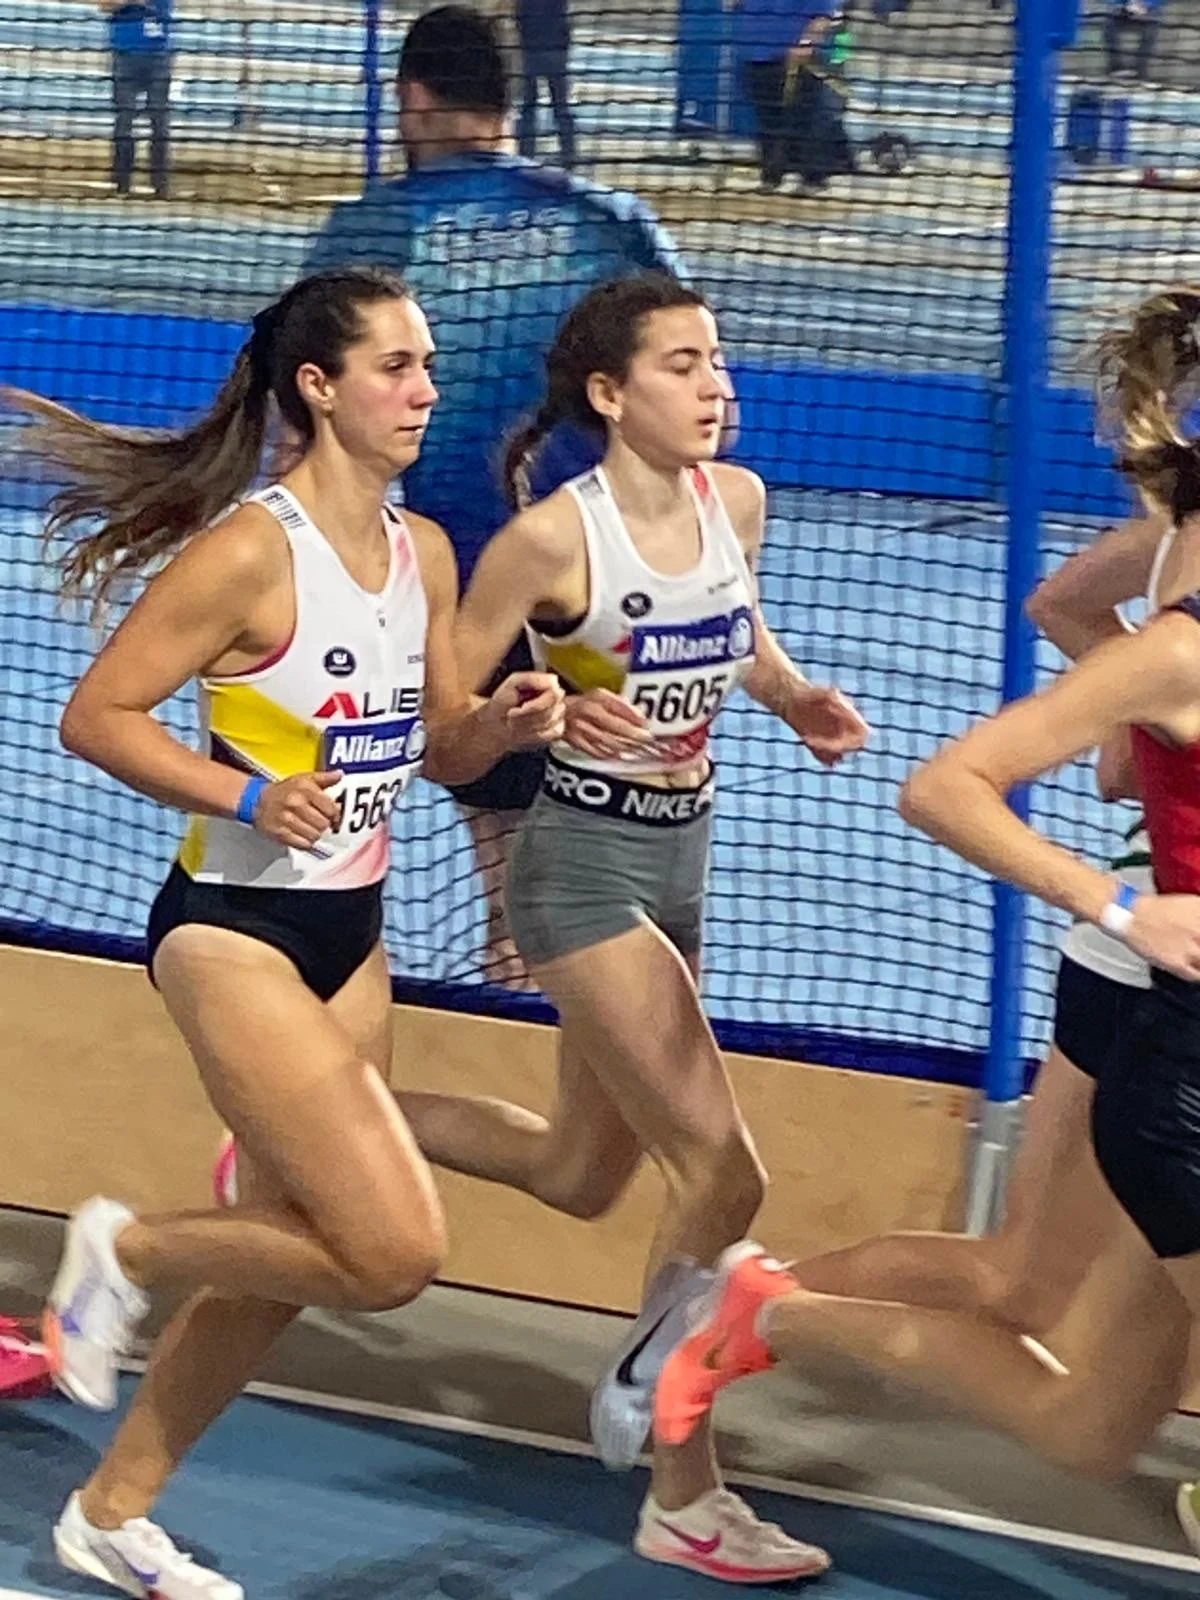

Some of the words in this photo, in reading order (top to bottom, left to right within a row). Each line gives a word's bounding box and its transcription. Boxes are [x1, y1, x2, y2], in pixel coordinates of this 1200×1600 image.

[639, 634, 727, 665] Allianz
[632, 674, 728, 723] 5605
[330, 734, 406, 765] Allianz
[545, 763, 611, 805] PRO
[621, 789, 695, 819] NIKE
